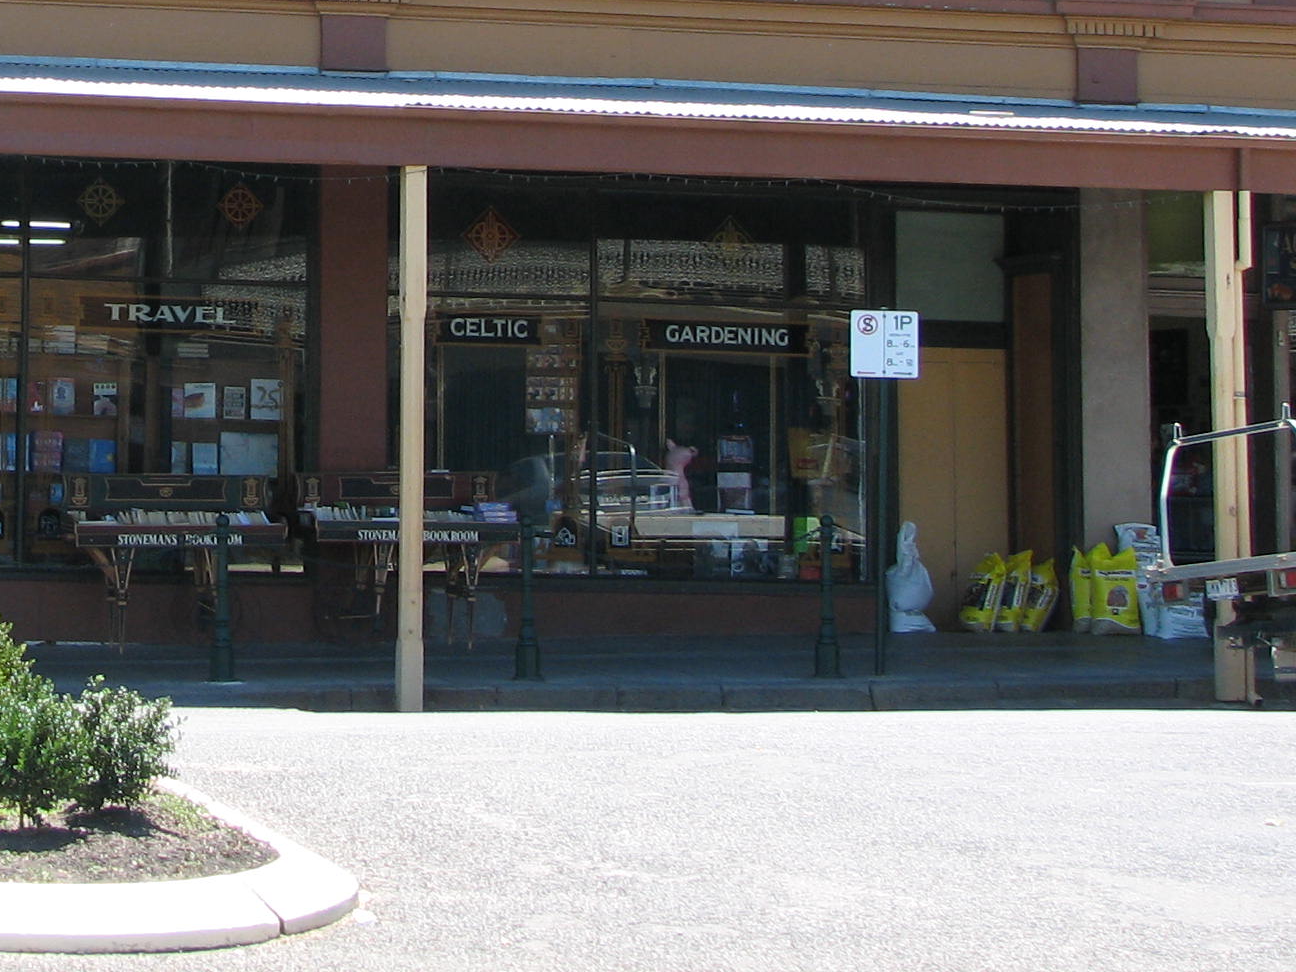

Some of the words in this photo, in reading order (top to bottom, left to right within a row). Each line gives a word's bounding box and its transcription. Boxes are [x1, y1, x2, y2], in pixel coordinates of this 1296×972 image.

[105, 303, 237, 325] TRAVEL
[893, 315, 913, 331] 1P
[450, 317, 529, 339] CELTIC
[665, 324, 790, 347] GARDENING
[118, 534, 177, 545] STONEMANS
[185, 534, 243, 545] BOOKOM
[357, 530, 401, 541] STONEM
